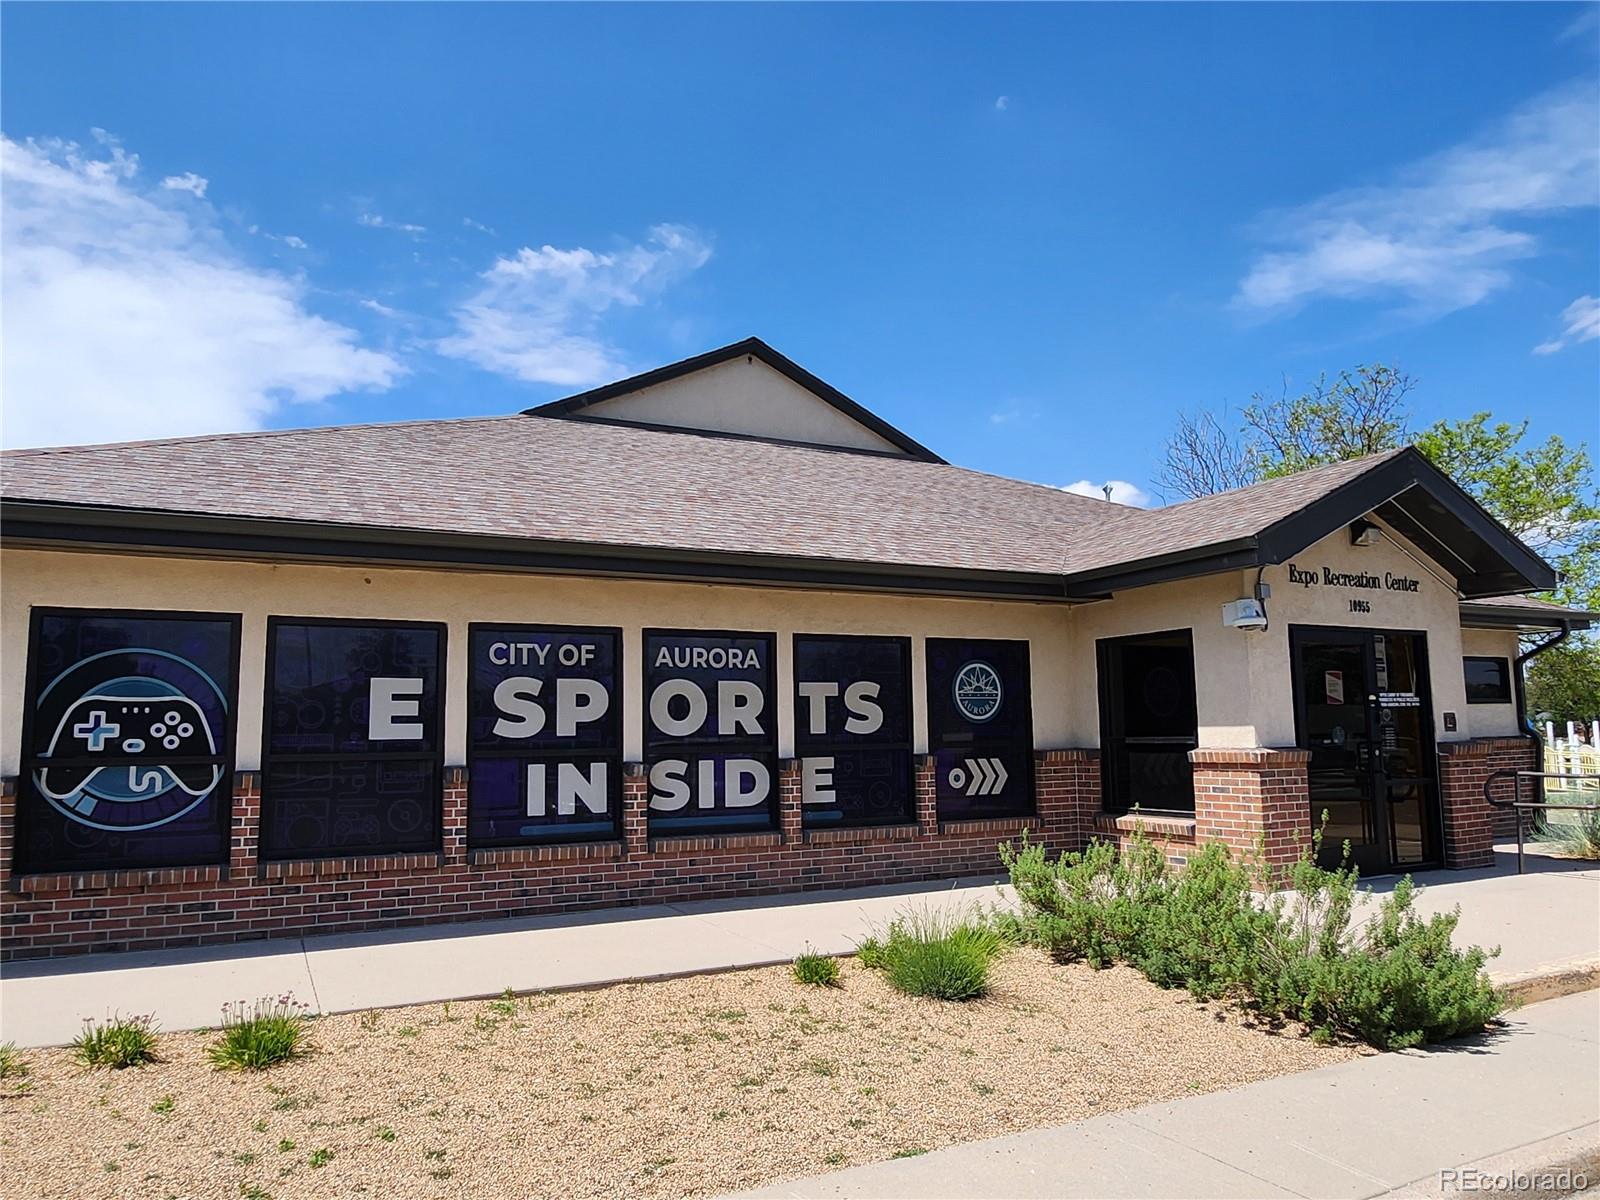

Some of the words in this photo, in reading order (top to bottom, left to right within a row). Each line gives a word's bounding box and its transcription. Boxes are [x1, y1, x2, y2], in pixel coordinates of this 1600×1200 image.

[1288, 563, 1319, 588] Expo
[1322, 566, 1381, 589] Recreation
[1385, 572, 1420, 592] Center
[1349, 599, 1371, 613] 10955
[488, 642, 552, 666] CITY
[558, 644, 596, 666] OF
[655, 646, 761, 670] AURORA
[962, 700, 995, 715] AURORA
